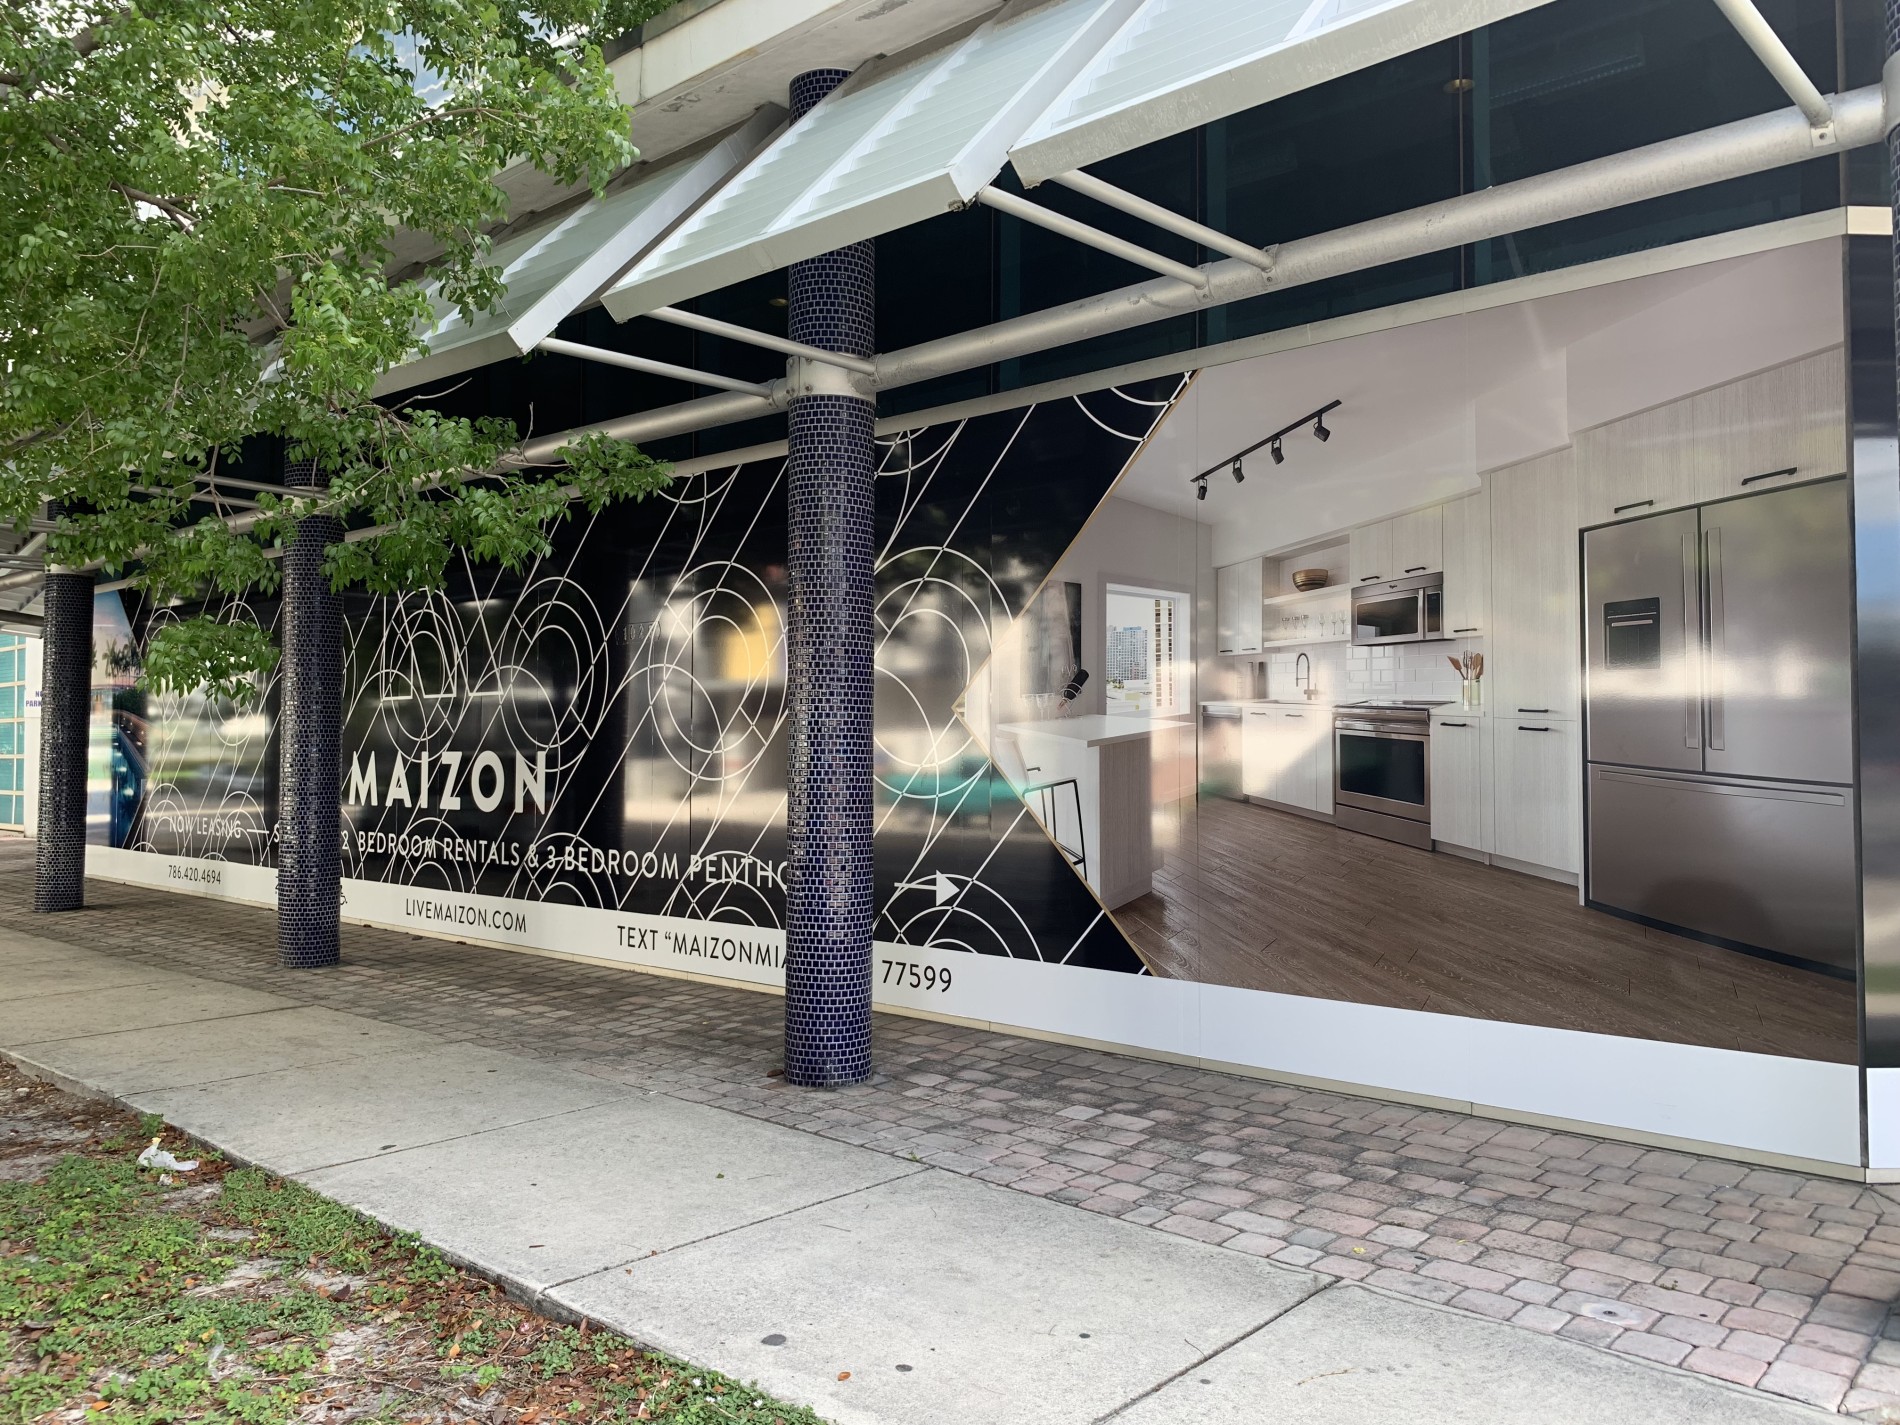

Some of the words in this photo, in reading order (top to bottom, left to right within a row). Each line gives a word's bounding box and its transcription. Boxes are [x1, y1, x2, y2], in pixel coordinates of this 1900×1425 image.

[348, 750, 547, 815] MAIZON
[168, 864, 222, 885] 786.420.4694
[169, 816, 194, 834] NOW
[196, 817, 242, 839] LEASING
[358, 830, 437, 860] BEDROOM
[443, 837, 520, 868] RENTALS
[527, 844, 540, 868] &
[547, 845, 556, 870] 3
[564, 846, 679, 881] BEDROOM
[406, 898, 527, 933] LIVEMAIZON.COM
[617, 925, 659, 951] TEXT
[665, 931, 787, 969] “MAIZONMI
[881, 959, 952, 993] 77599
